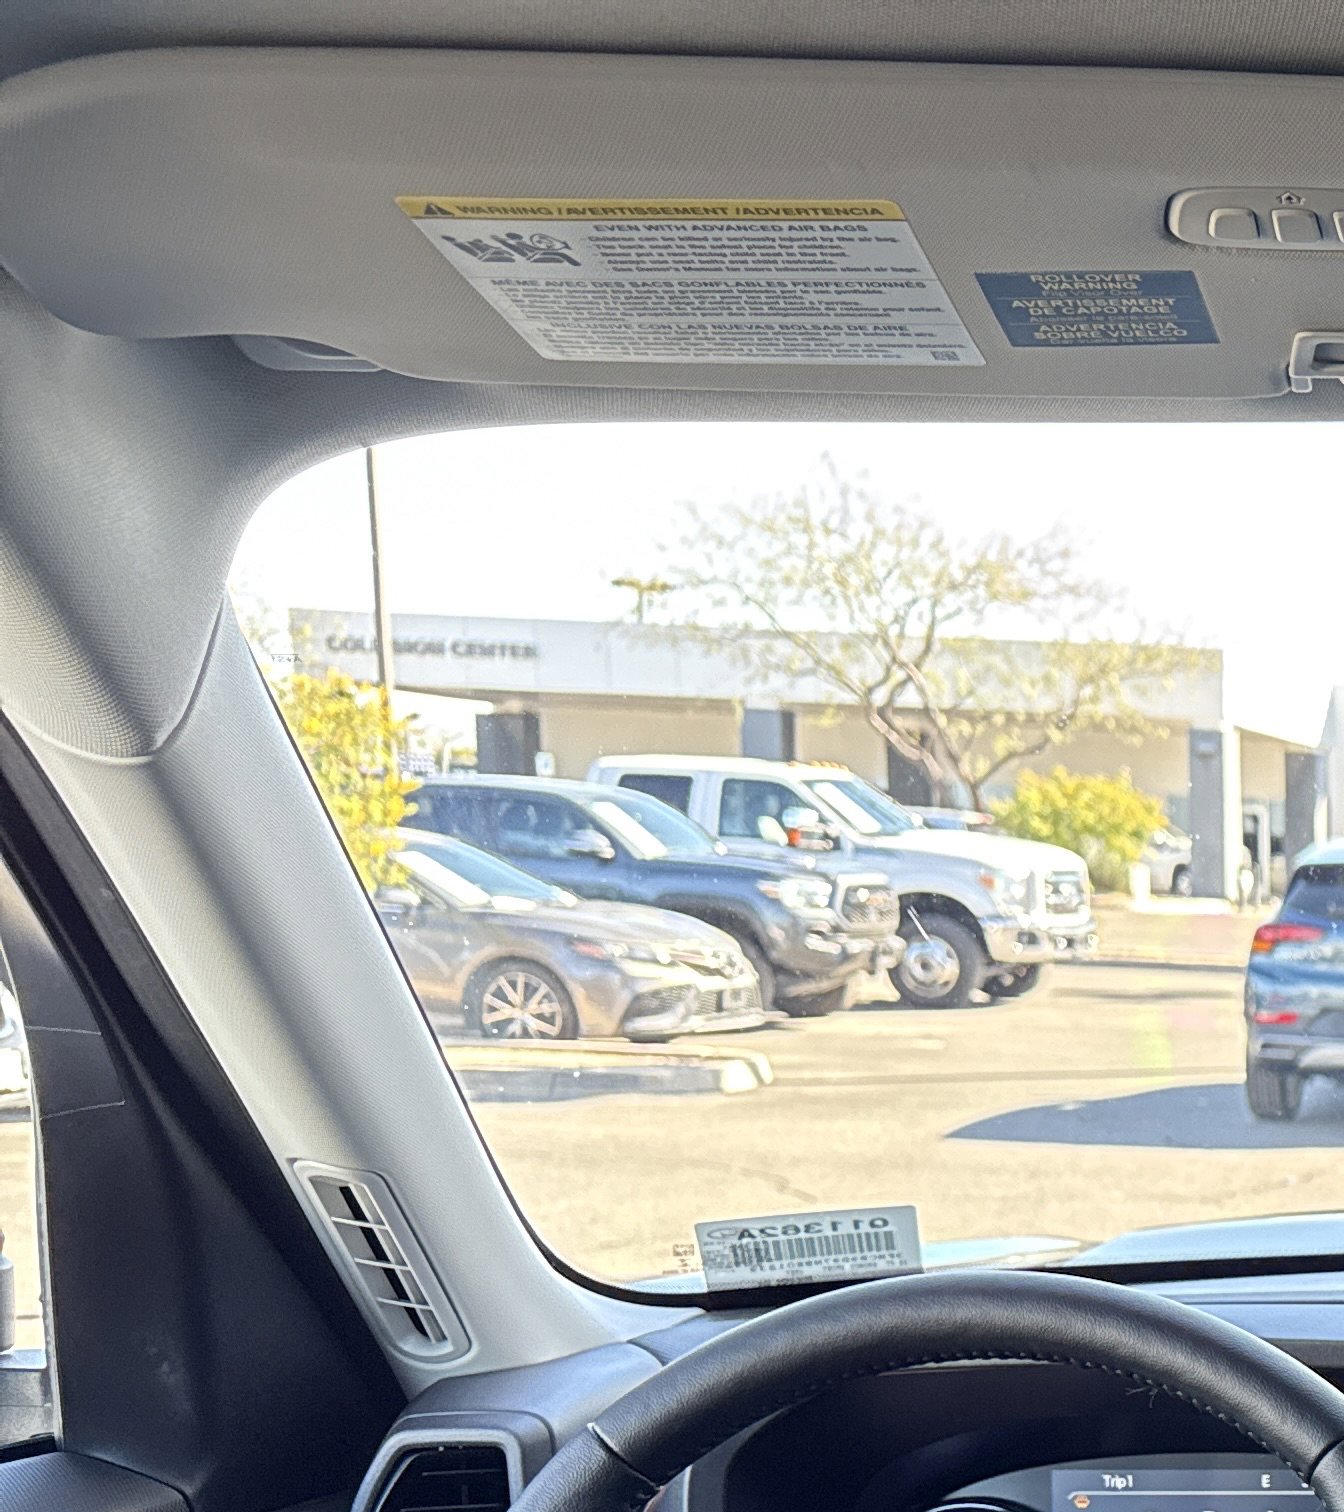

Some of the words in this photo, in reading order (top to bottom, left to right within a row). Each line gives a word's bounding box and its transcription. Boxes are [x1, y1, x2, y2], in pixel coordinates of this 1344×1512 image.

[457, 206, 553, 216] WARNING
[593, 224, 640, 232] EVEN
[643, 224, 687, 232] WITH
[691, 224, 783, 232] ADVANCED
[1030, 274, 1143, 283] ROLLOVER
[544, 280, 588, 288] AVEC
[1040, 282, 1138, 290] WARNING
[1012, 298, 1176, 309] AVERTISSEMENT
[1062, 305, 1171, 315] CAPOTAGE
[1039, 322, 1178, 332] ADVERTENCIA
[1034, 331, 1103, 340] SOBRE
[1108, 329, 1188, 337] VUELCO
[452, 639, 538, 658] CENTER
[1102, 1474, 1126, 1489] Trip
[1261, 1474, 1271, 1488] E
